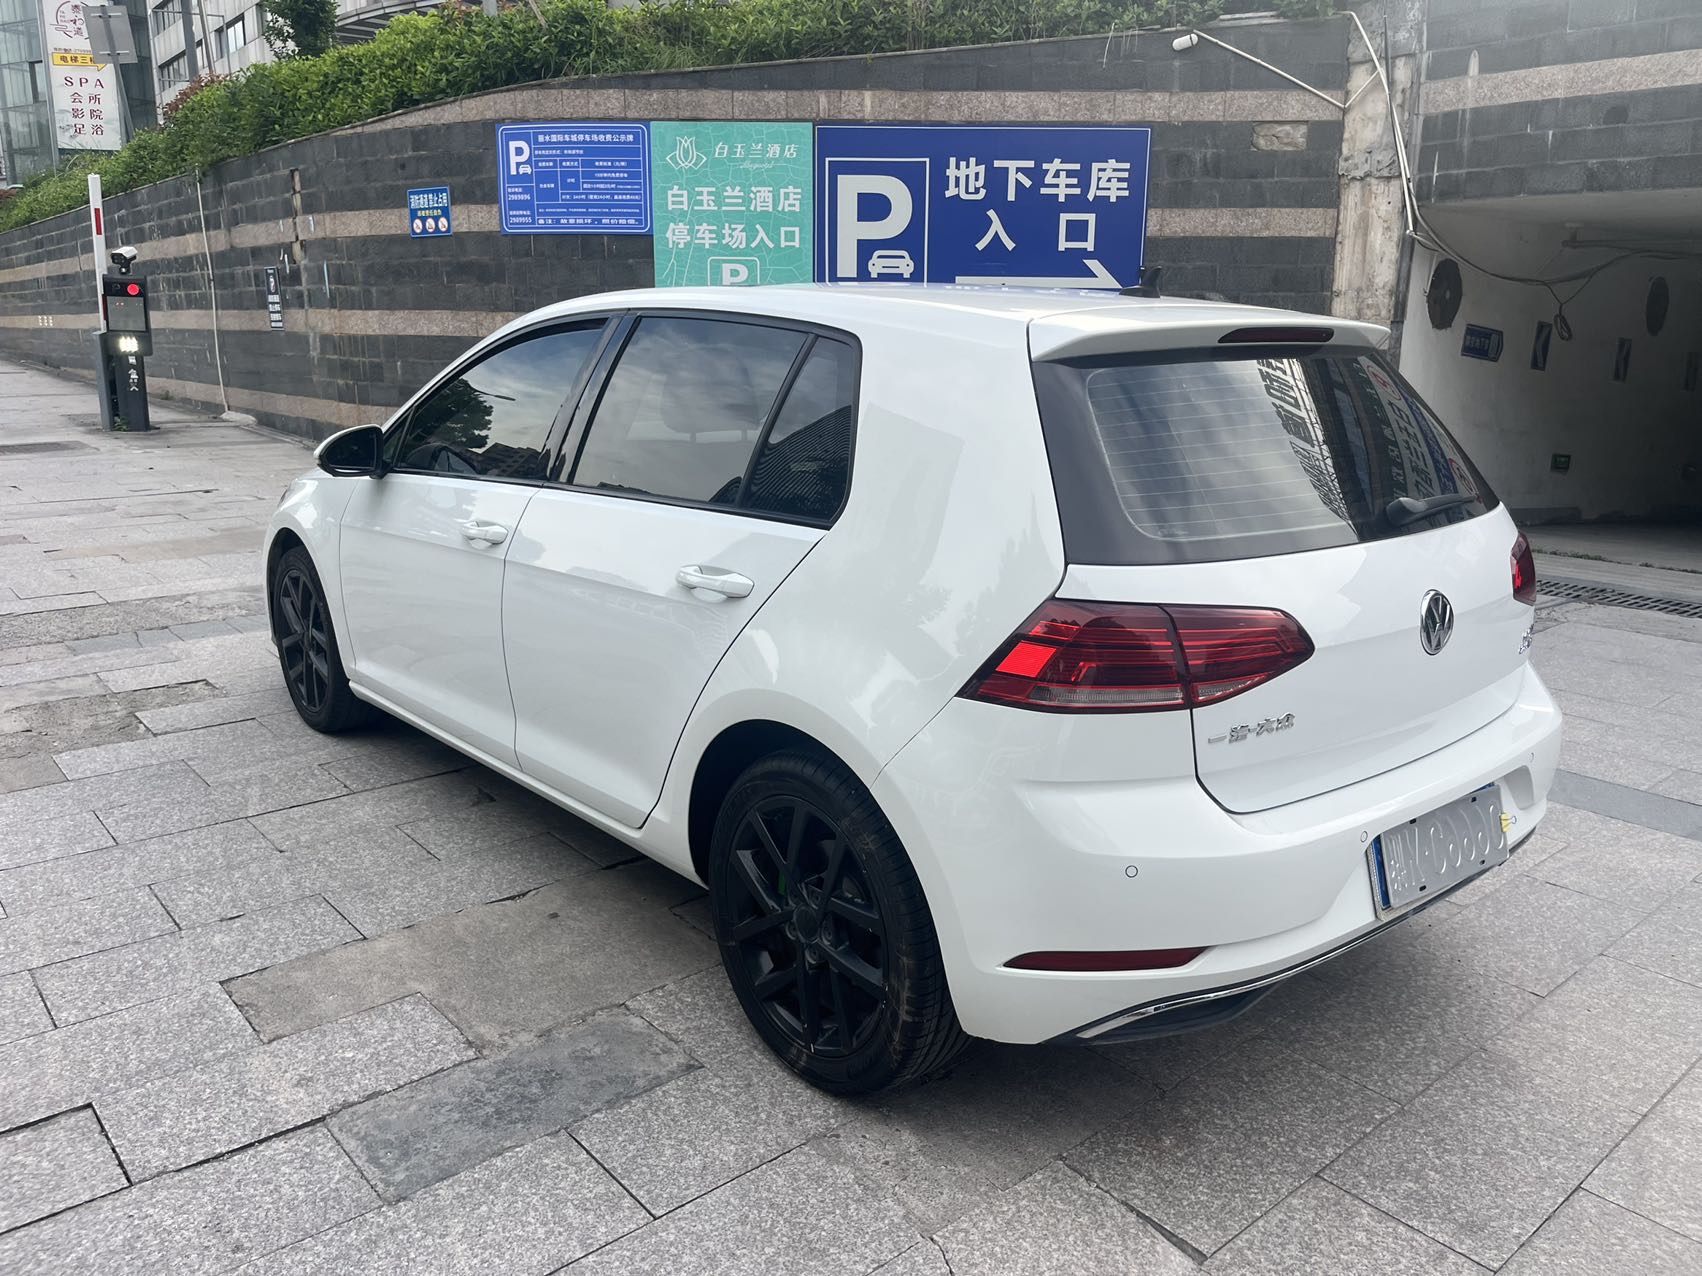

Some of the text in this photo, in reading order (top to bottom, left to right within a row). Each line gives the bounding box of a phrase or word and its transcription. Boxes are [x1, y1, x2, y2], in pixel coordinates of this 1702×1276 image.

[64, 76, 105, 89] SPA
[70, 92, 101, 105] 会所
[71, 108, 104, 121] 影院
[73, 124, 104, 136] 足浴
[508, 140, 530, 175] P
[714, 142, 799, 158] 白玉兰酒店
[944, 156, 1131, 203] 地下车库
[667, 185, 802, 213] 白玉兰酒店
[665, 222, 801, 249] 停车场入口
[836, 174, 913, 278] P
[974, 208, 1097, 252] 入口
[721, 263, 749, 286] P
